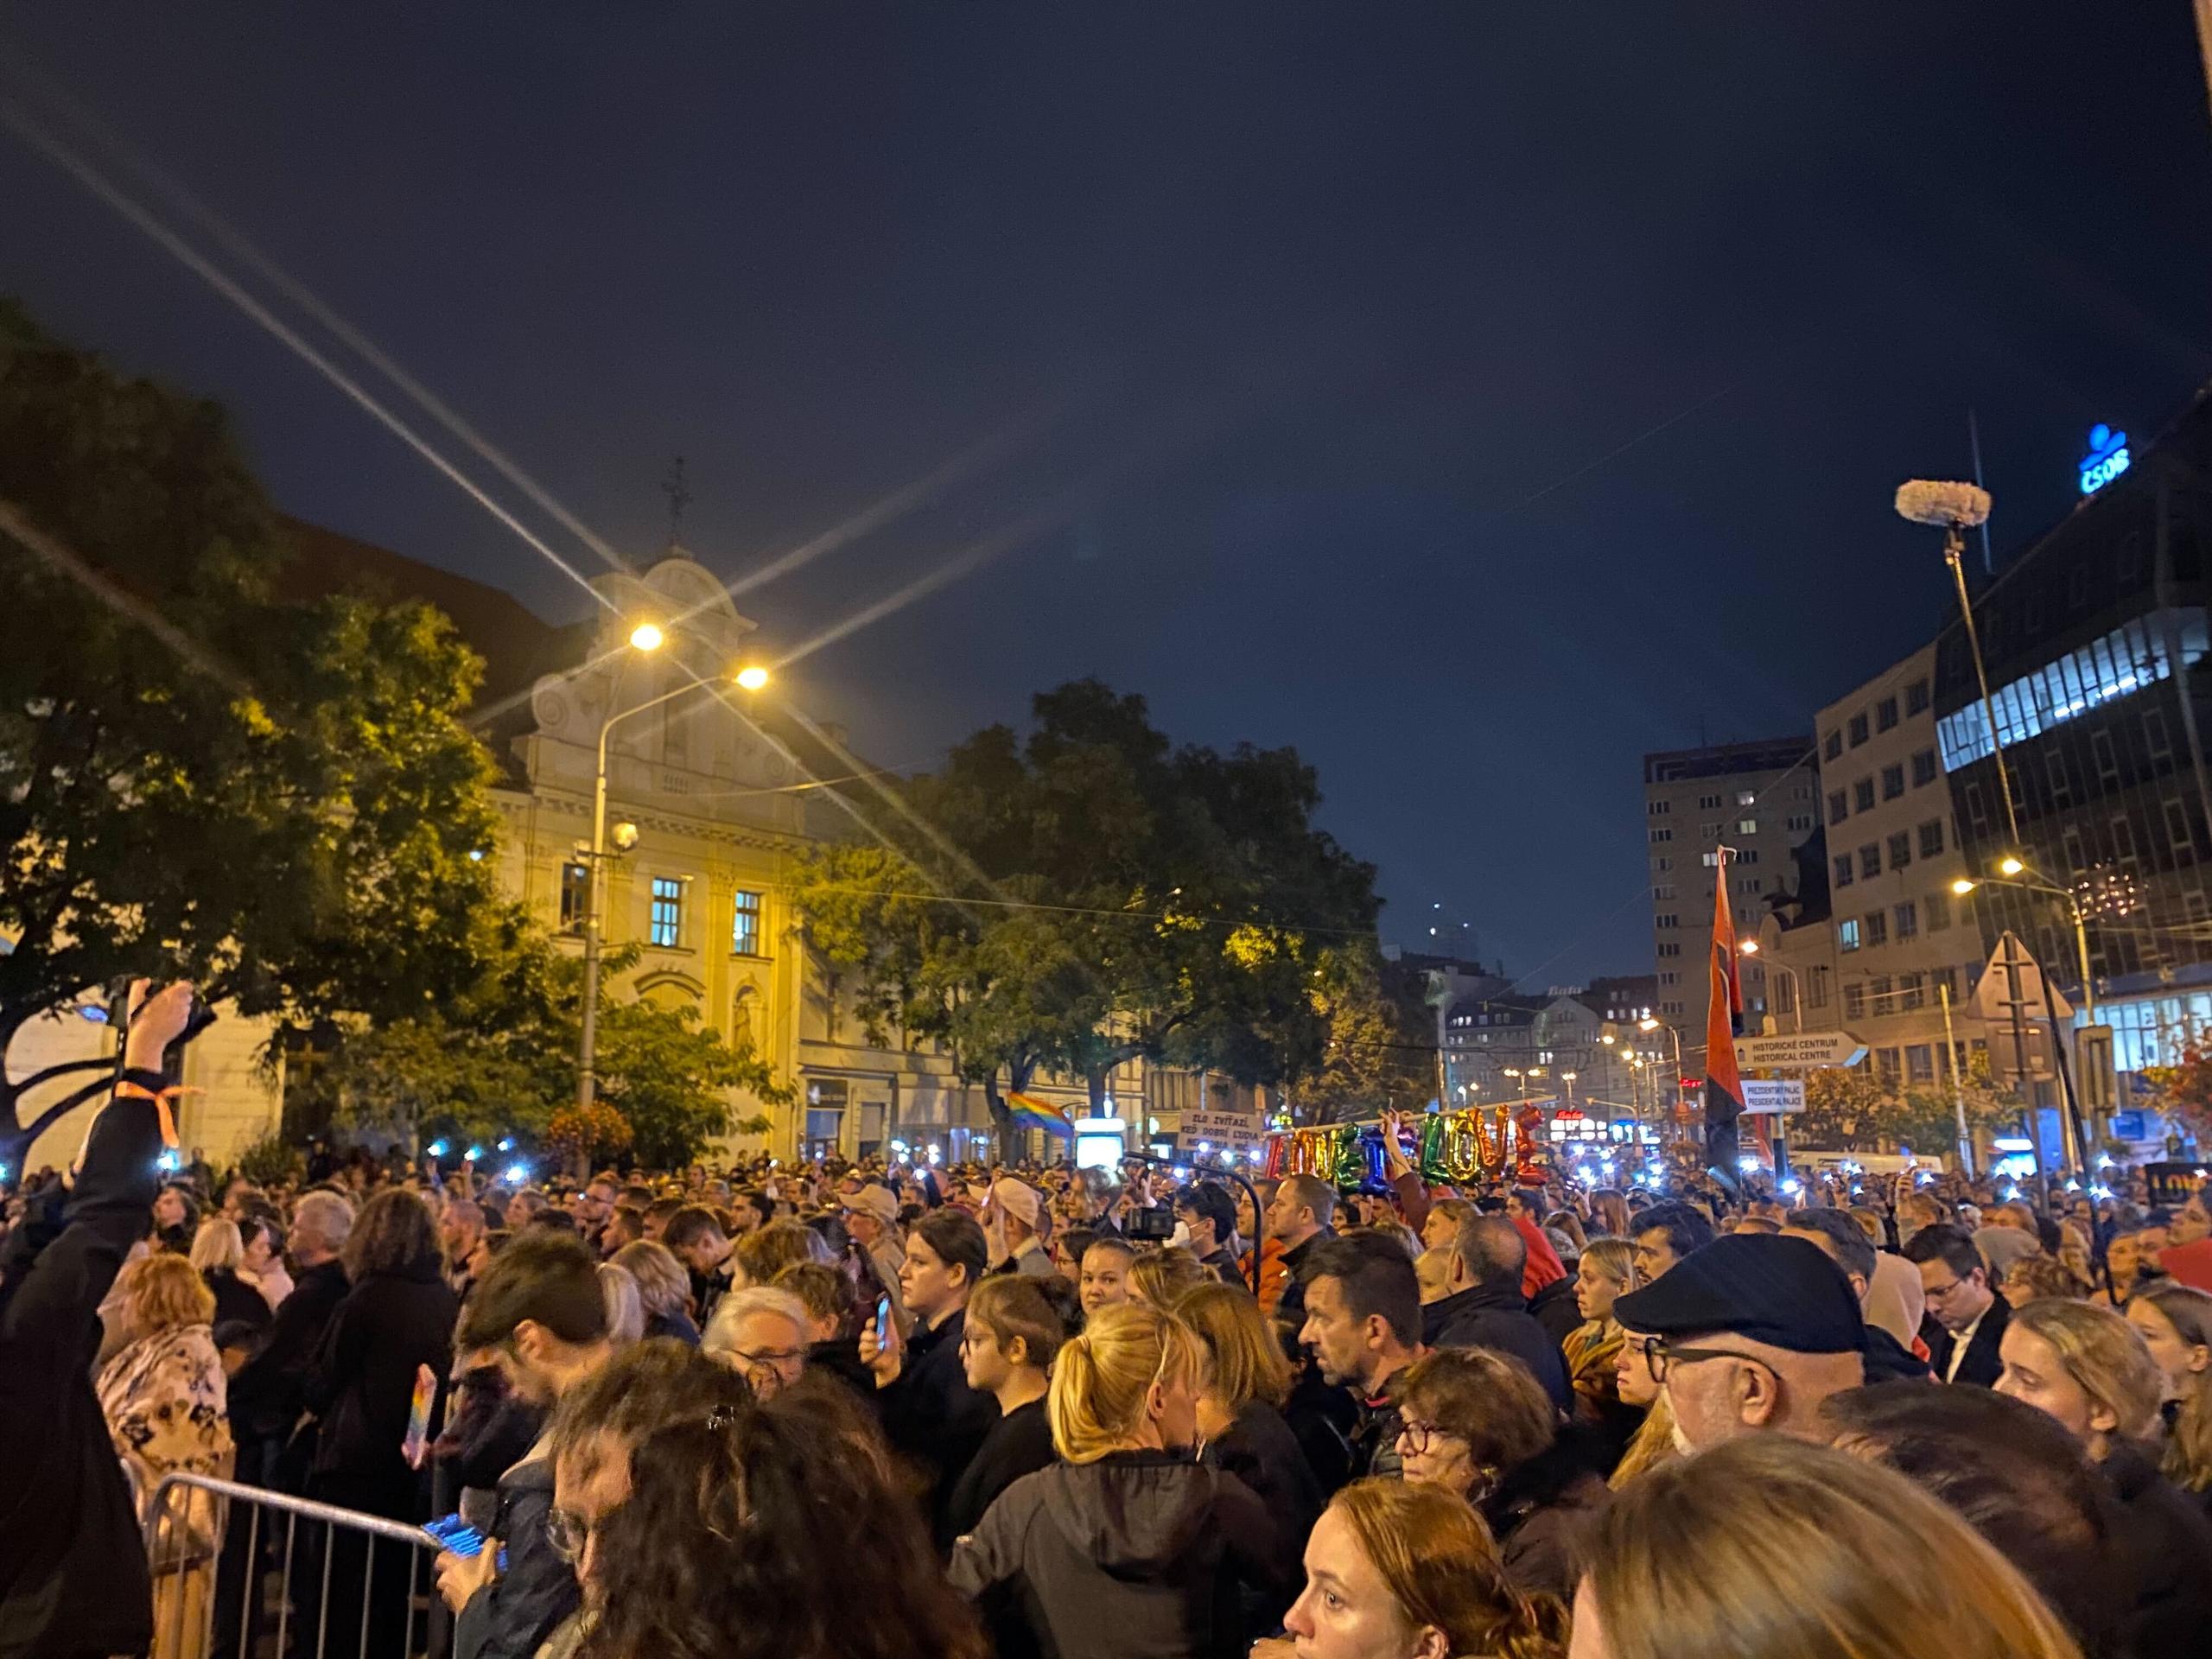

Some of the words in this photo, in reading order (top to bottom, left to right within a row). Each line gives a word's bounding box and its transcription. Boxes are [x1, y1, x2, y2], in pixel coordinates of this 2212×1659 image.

[1752, 1040, 1797, 1052] HISTORICKÉ
[1799, 1039, 1838, 1049] CENTRUM
[1753, 1052, 1798, 1063] HISTORICAL
[1799, 1050, 1831, 1060] CENTRE
[1748, 1097, 1783, 1106] PRESIDENTIAL
[1783, 1096, 1802, 1106] PALACE
[1192, 1114, 1208, 1123] ZLO
[1421, 1102, 1549, 1186] LOVE
